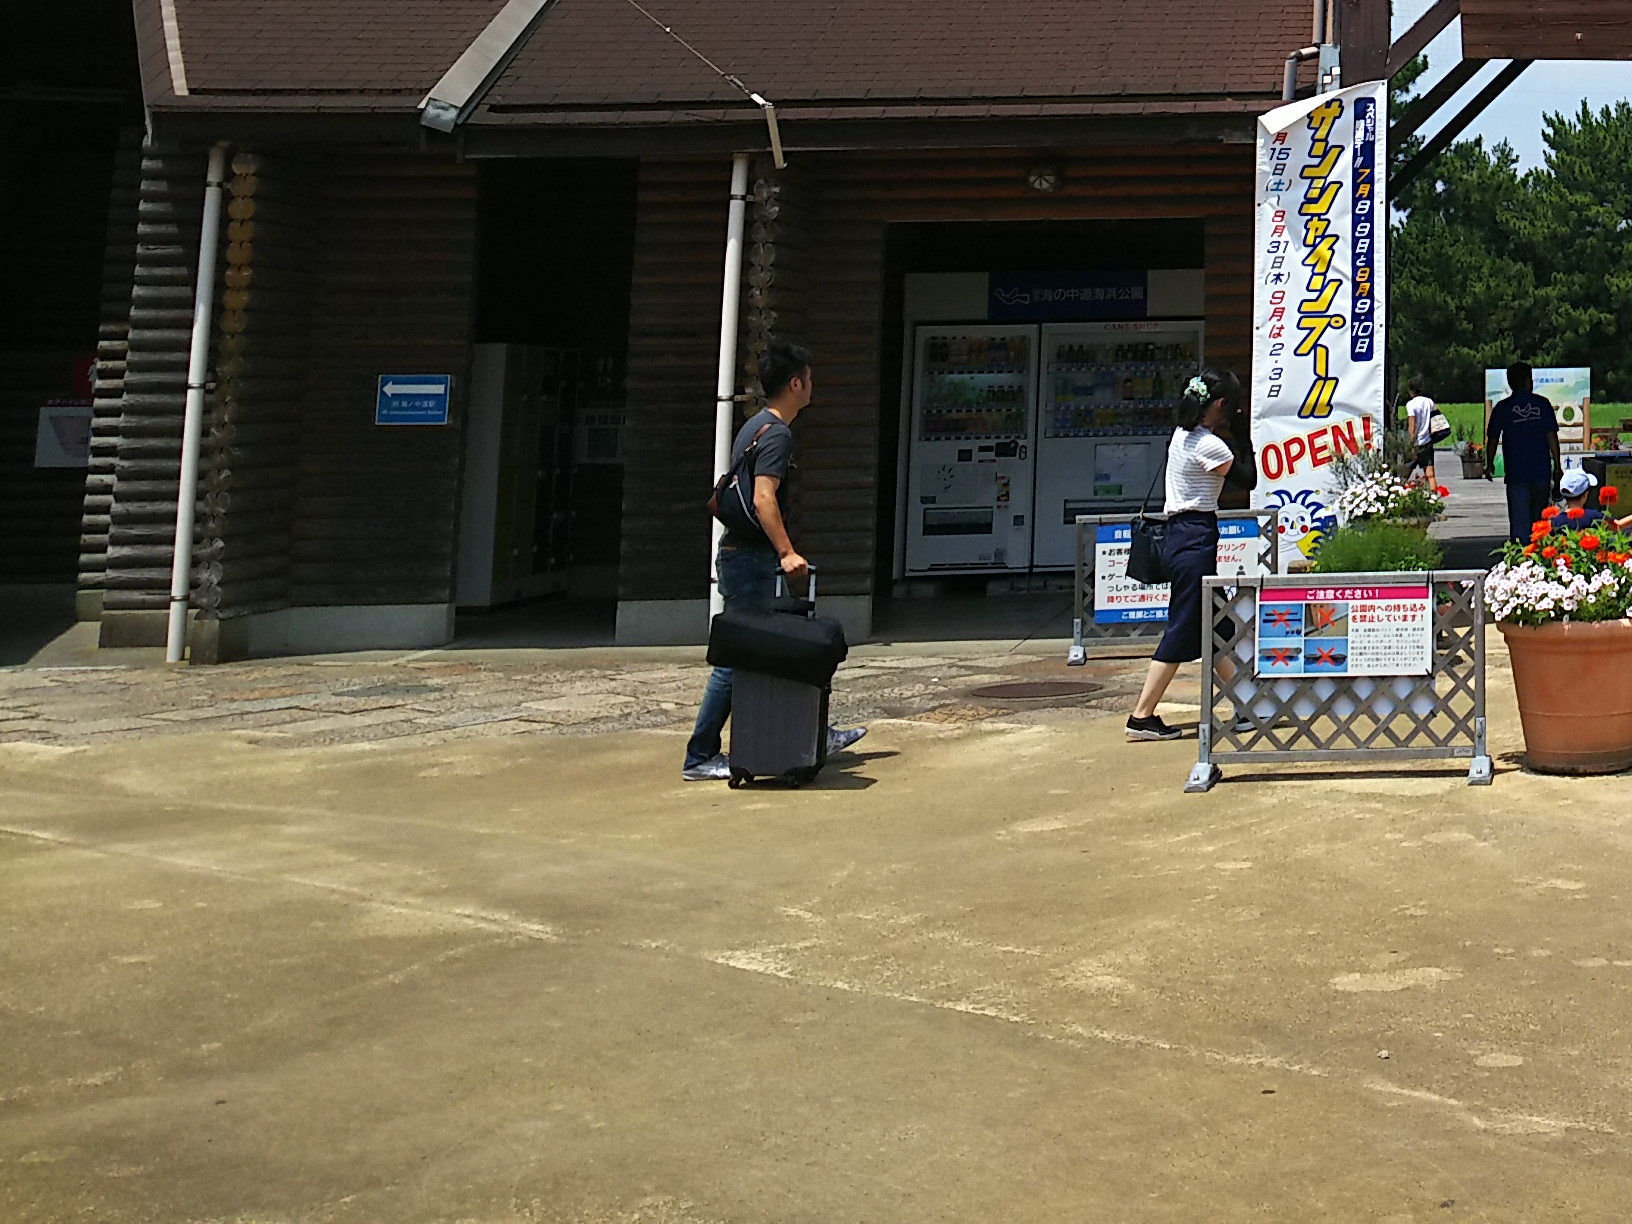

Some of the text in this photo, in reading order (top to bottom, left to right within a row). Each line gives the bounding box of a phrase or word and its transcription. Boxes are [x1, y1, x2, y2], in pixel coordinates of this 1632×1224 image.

[1294, 98, 1346, 419] サンシャインプール
[1261, 415, 1373, 480] OPEN!
[1306, 588, 1379, 599] ご注意ください!
[1351, 603, 1426, 613] 公園内への持ち込み
[1351, 614, 1424, 623] を禁止しています!
